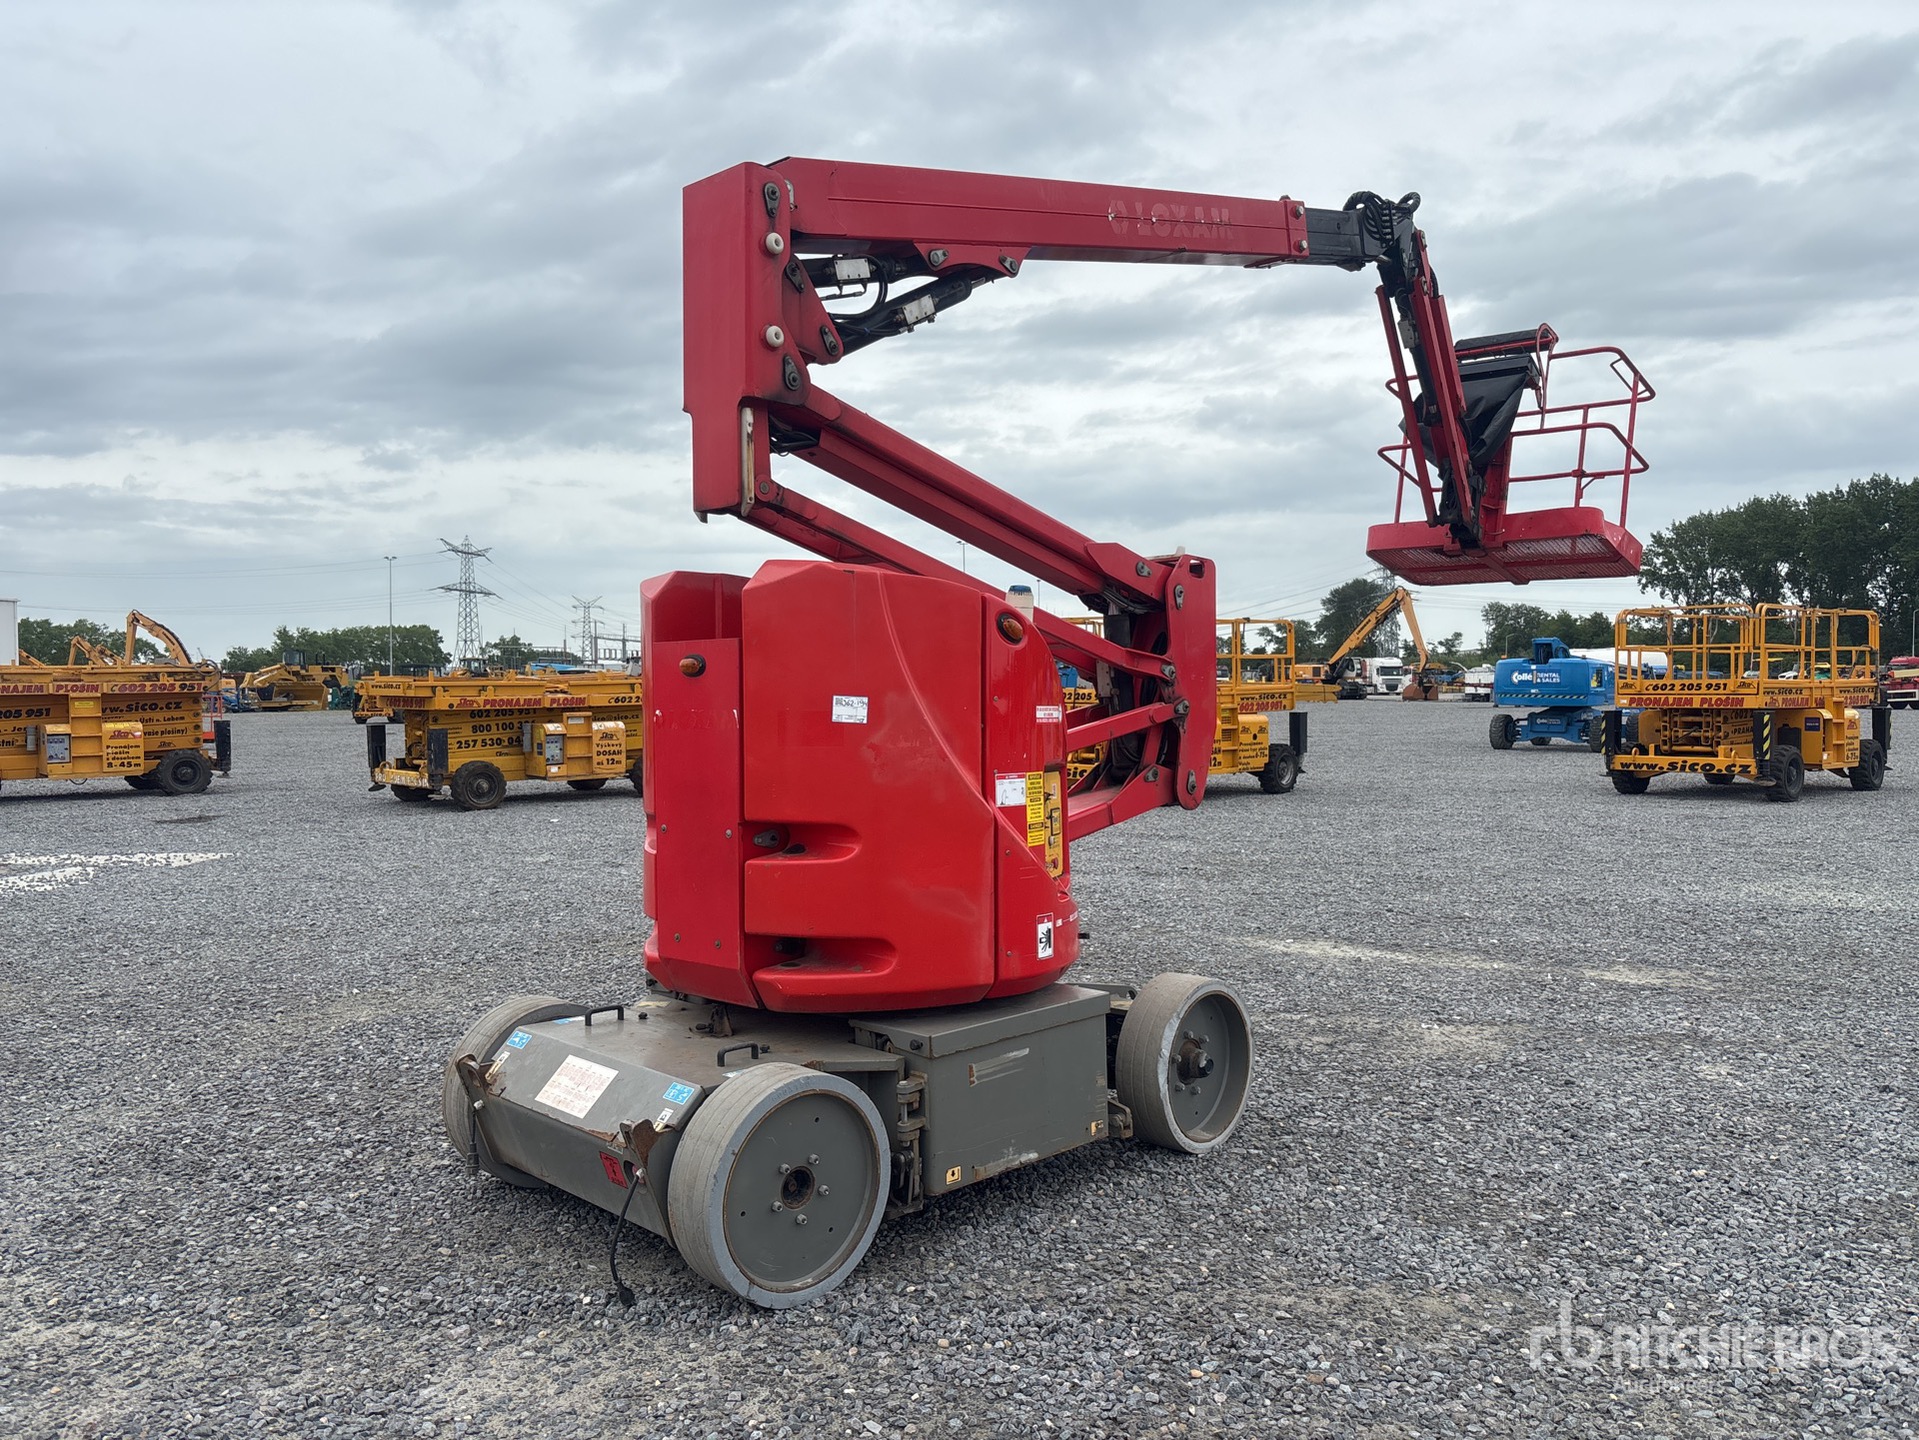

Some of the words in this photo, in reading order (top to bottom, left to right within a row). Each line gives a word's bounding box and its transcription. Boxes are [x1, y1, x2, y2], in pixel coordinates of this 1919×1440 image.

[1135, 201, 1234, 239] LOXAM
[118, 683, 146, 692] 602
[149, 683, 176, 692] 205
[179, 682, 202, 692] 951
[1679, 683, 1702, 691] 205
[1705, 682, 1727, 691] 951
[1763, 688, 1803, 696] www.sico.cz
[483, 697, 541, 708] PRONÁJEM
[1240, 693, 1287, 701] www.sico.cz
[1628, 696, 1693, 707] PRONÁJEM
[1700, 696, 1744, 707] PLOŠIN
[1240, 702, 1254, 711] 602
[1256, 701, 1269, 710] 205
[1270, 701, 1282, 710] 951
[25, 708, 51, 717] 951
[470, 709, 491, 719] 602
[494, 708, 514, 716] 205
[472, 724, 492, 734] 800
[495, 722, 514, 732] 100
[456, 739, 478, 749] 257
[481, 738, 502, 747] 530
[507, 736, 523, 745] 04
[1620, 760, 1752, 774] www.sico.cz
